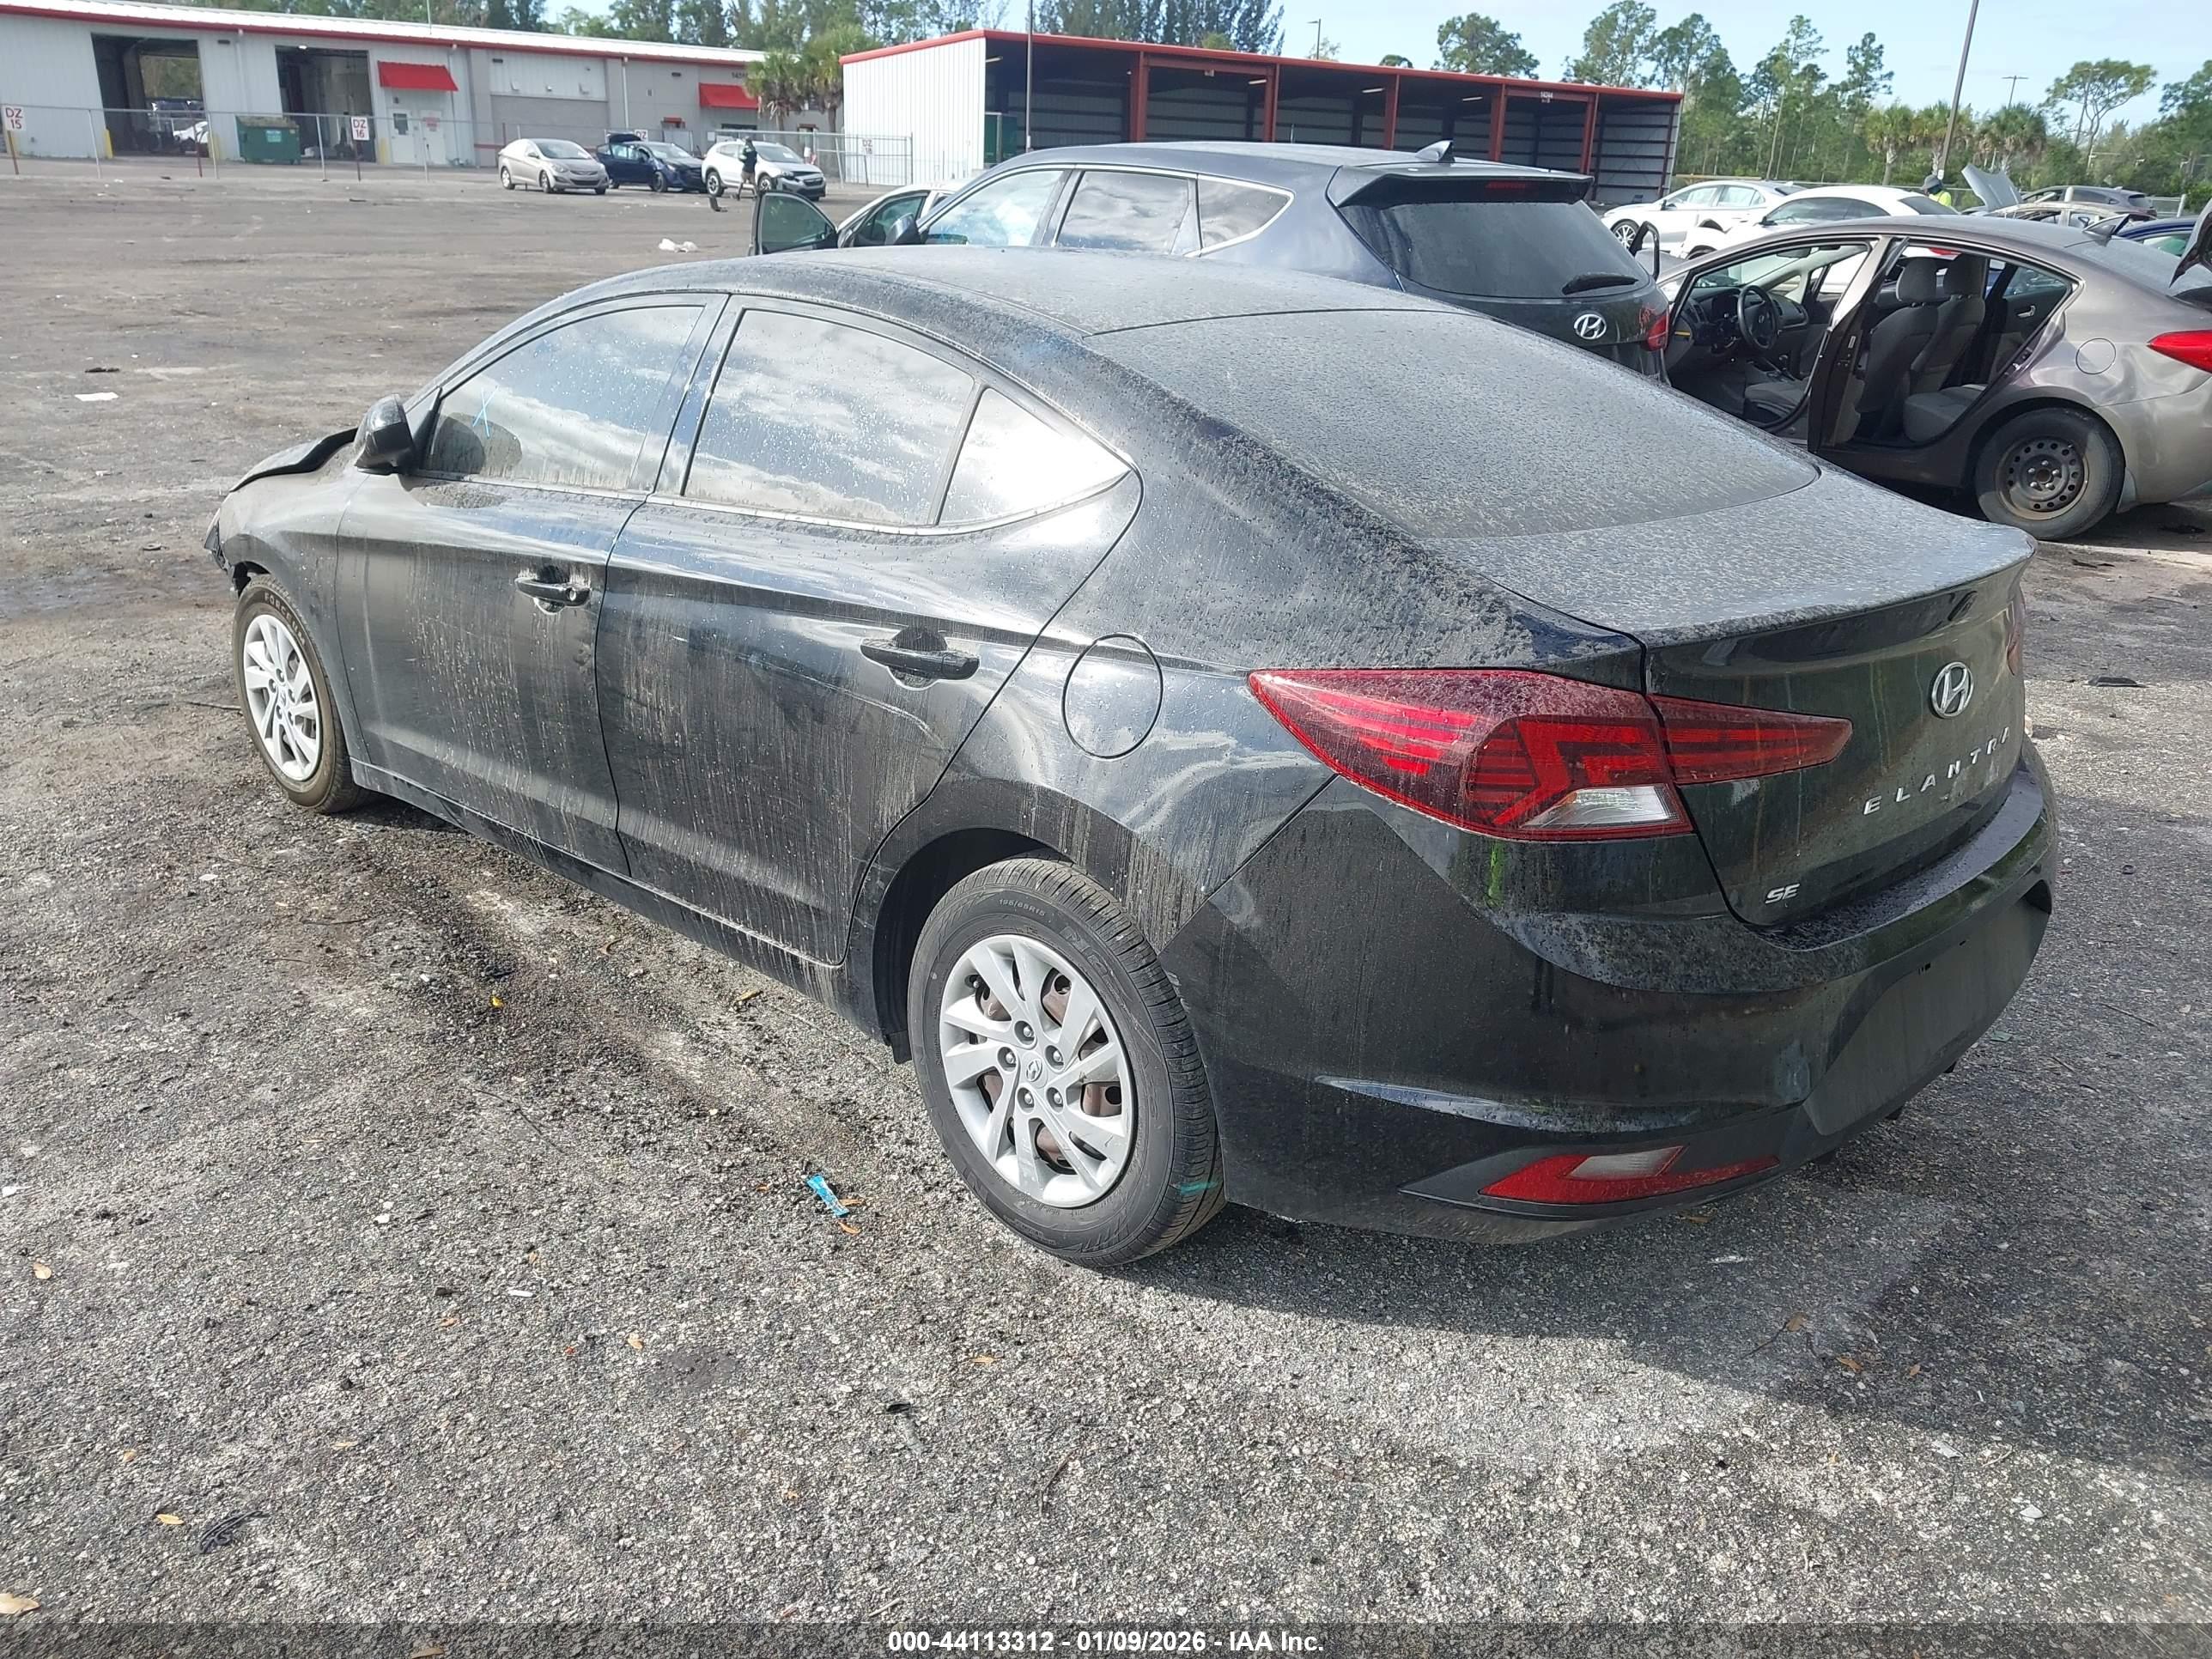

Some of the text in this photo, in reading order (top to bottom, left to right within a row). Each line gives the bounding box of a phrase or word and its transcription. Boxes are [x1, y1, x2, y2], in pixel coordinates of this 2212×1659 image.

[5, 107, 23, 118] DZ
[11, 119, 22, 129] 15
[353, 118, 367, 129] DZ
[356, 129, 365, 138] 16
[1863, 726, 2009, 815] ELANTRA
[1765, 883, 1801, 904] SE
